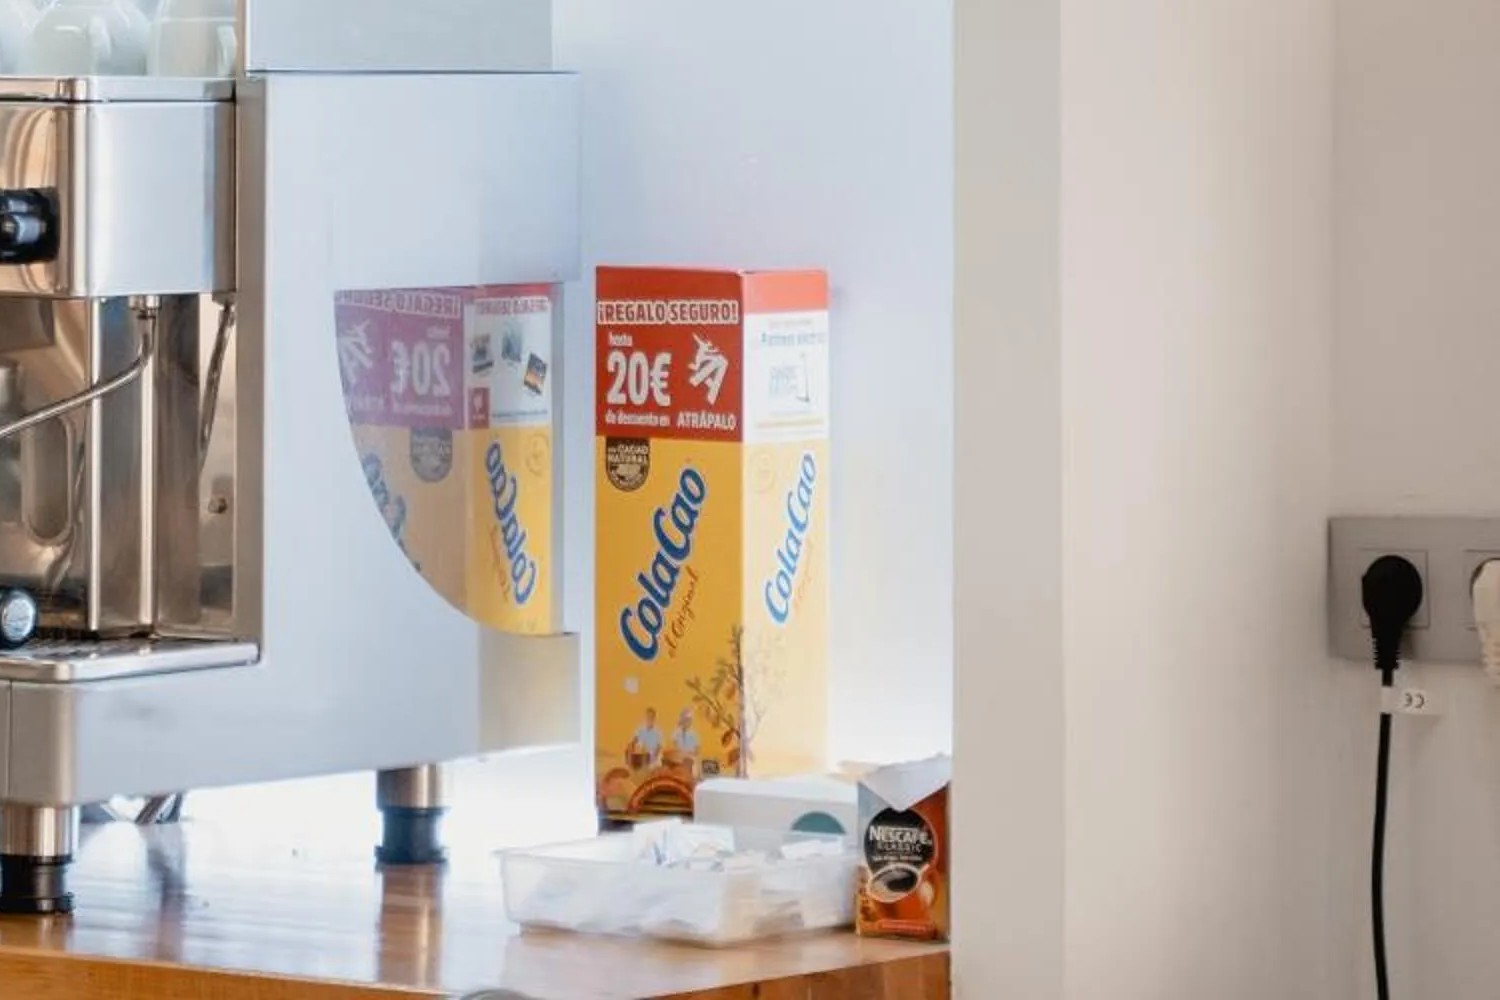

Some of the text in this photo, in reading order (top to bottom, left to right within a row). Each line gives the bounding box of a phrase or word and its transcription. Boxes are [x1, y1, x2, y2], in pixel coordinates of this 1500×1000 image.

[599, 301, 737, 322] ¡REGALO SEGURO!
[607, 350, 672, 407] 20€
[677, 409, 737, 431] ATRÁPALO
[620, 467, 707, 661] ColaCao
[765, 453, 816, 623] ColaCao
